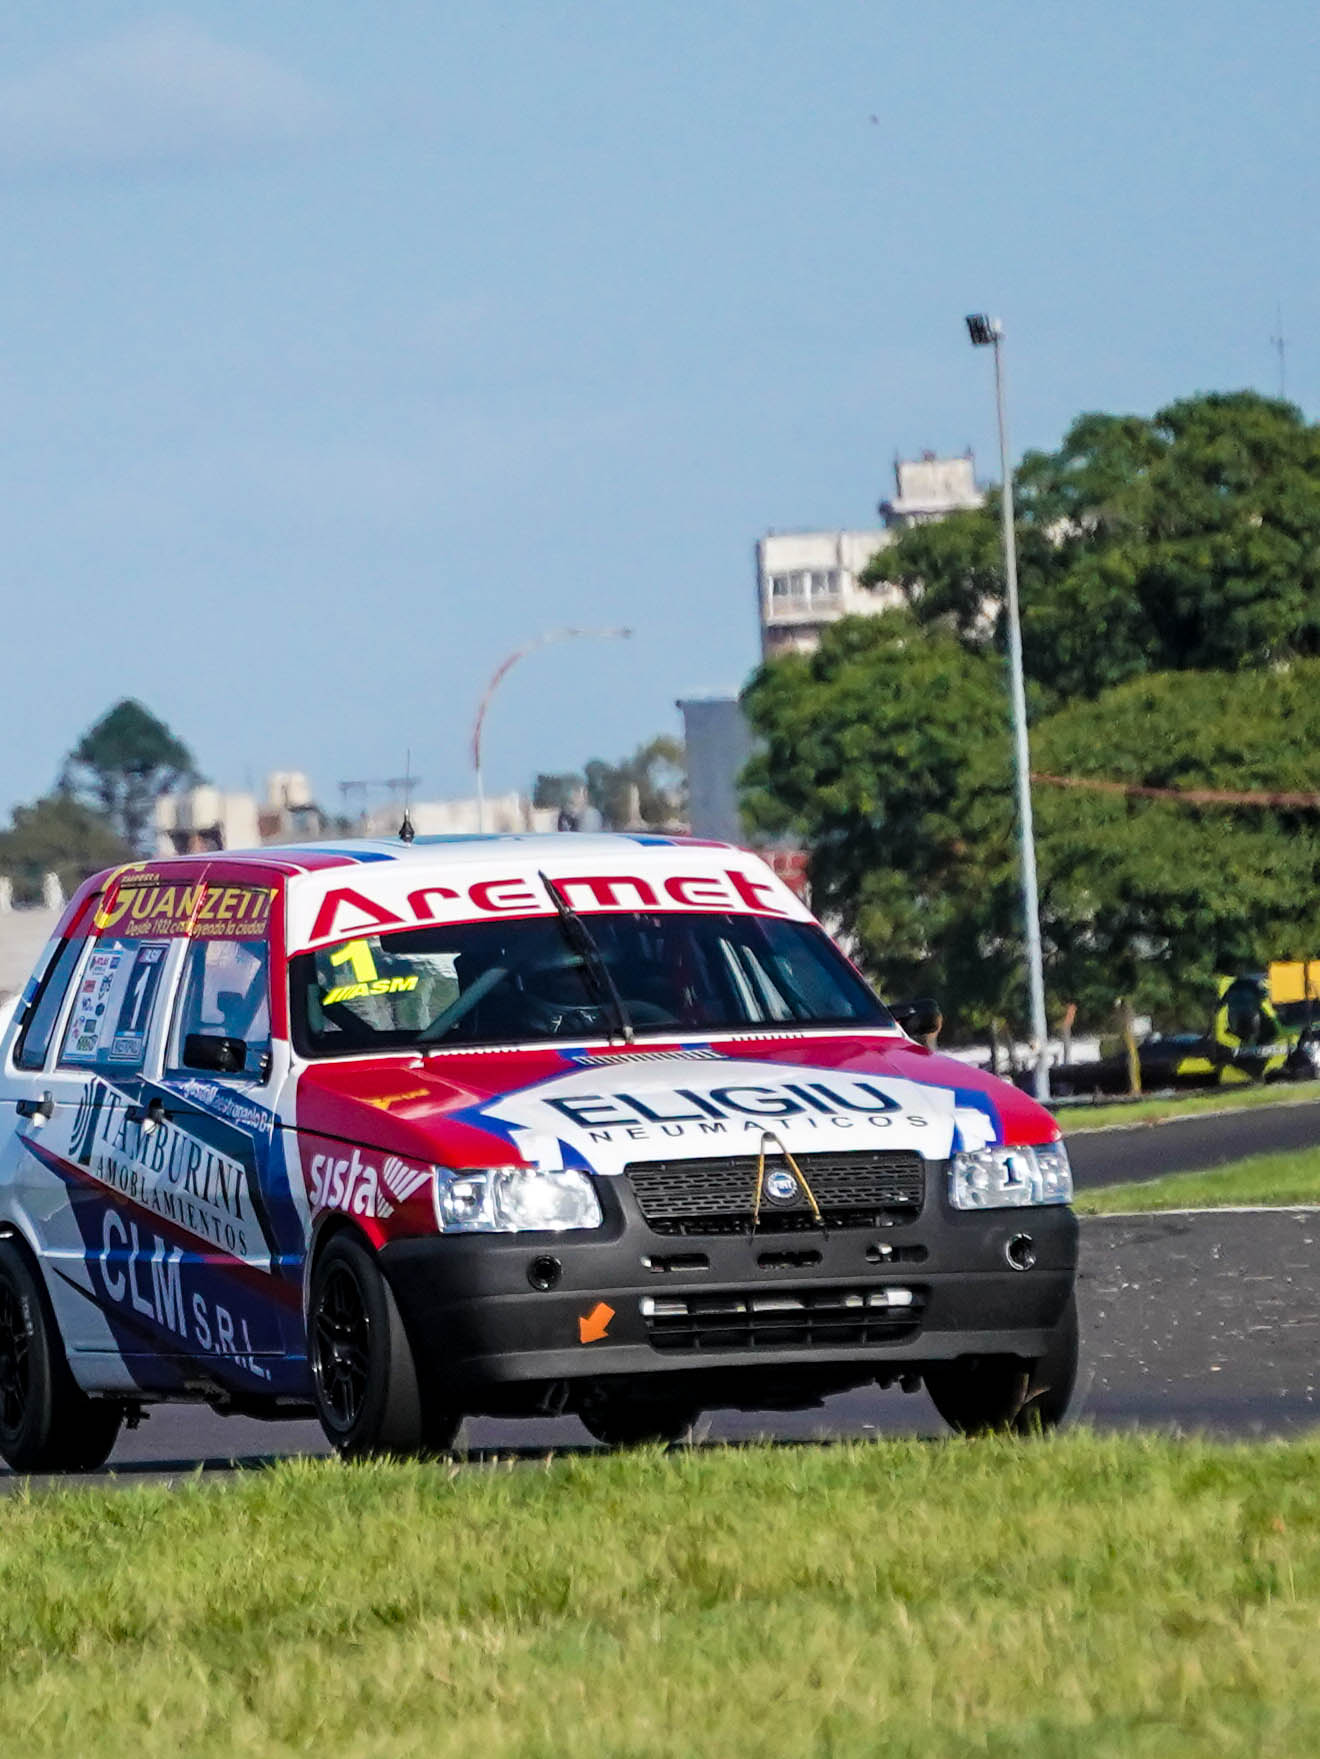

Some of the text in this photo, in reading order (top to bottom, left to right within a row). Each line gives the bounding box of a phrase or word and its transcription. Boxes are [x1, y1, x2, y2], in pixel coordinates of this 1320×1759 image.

[329, 938, 379, 986] 1
[540, 1083, 902, 1130] ELIGIU
[589, 1115, 929, 1144] NEUMATICOS
[102, 1089, 247, 1222] TAMBURINI
[309, 1149, 378, 1218] sista
[1002, 1157, 1023, 1188] 1
[96, 1156, 248, 1257] AMOBLAMIENTOS
[101, 1209, 188, 1338] CLM
